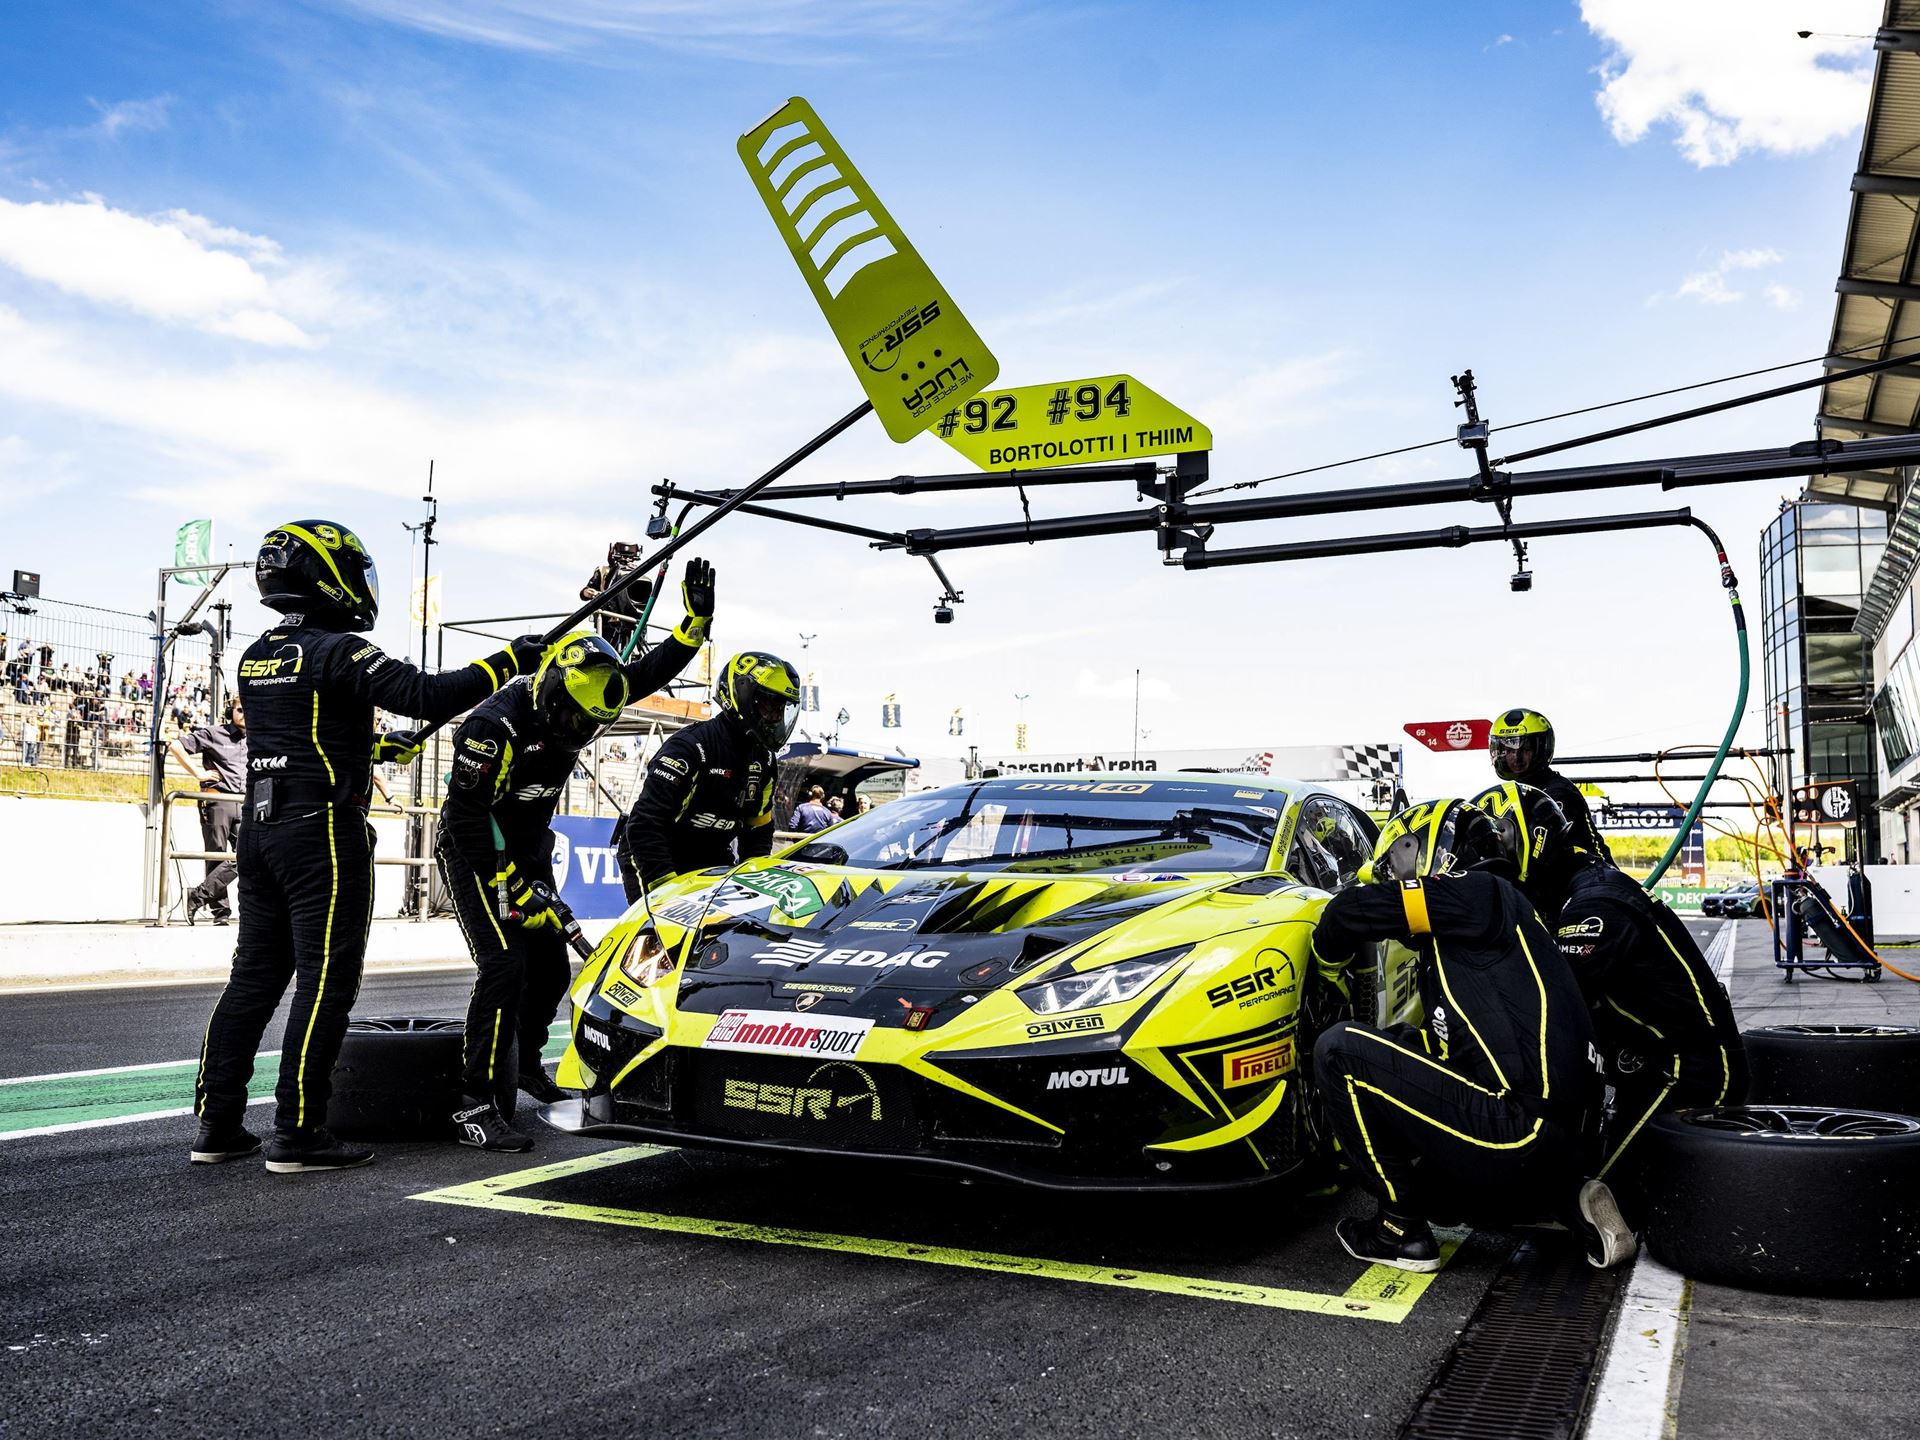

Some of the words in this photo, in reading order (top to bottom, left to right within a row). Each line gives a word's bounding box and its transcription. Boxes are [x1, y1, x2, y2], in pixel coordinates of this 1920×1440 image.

[859, 305, 918, 350] PERFORMANCE
[883, 300, 941, 352] SSR
[902, 357, 969, 410] LUCA
[958, 372, 975, 385] WE
[933, 383, 958, 404] RACE
[912, 402, 932, 418] FOR
[937, 394, 1018, 438] #92
[1047, 380, 1131, 425] #94
[990, 435, 1114, 465] BORTOLOTTI
[1136, 426, 1193, 448] THIIM
[240, 658, 282, 677] SSR
[734, 655, 775, 685] 94
[248, 676, 298, 686] PERFORMANCE
[588, 705, 615, 718] SSR
[464, 737, 488, 752] SSR
[1428, 738, 1438, 746] 14
[251, 755, 287, 771] DTM
[659, 756, 681, 768] SSR
[1246, 765, 1267, 773] Arena
[1015, 783, 1096, 792] DTM
[1100, 784, 1140, 792] 40
[736, 871, 812, 913] DEKRA
[659, 902, 717, 925] ADAC
[849, 921, 899, 929] SSR
[1558, 924, 1590, 938] SSR
[817, 949, 951, 969] EDAG
[782, 982, 856, 994] SIEGERDESIGNS
[1207, 966, 1276, 1009] SSR
[1239, 984, 1297, 1011] PERFORMANCE
[716, 1013, 745, 1028] Auto
[584, 1024, 611, 1051] MOTUL
[710, 1026, 735, 1041] Bild
[1231, 1042, 1291, 1082] PIRELLI
[1047, 1067, 1130, 1090] MOTUL
[724, 1078, 832, 1120] SSR
